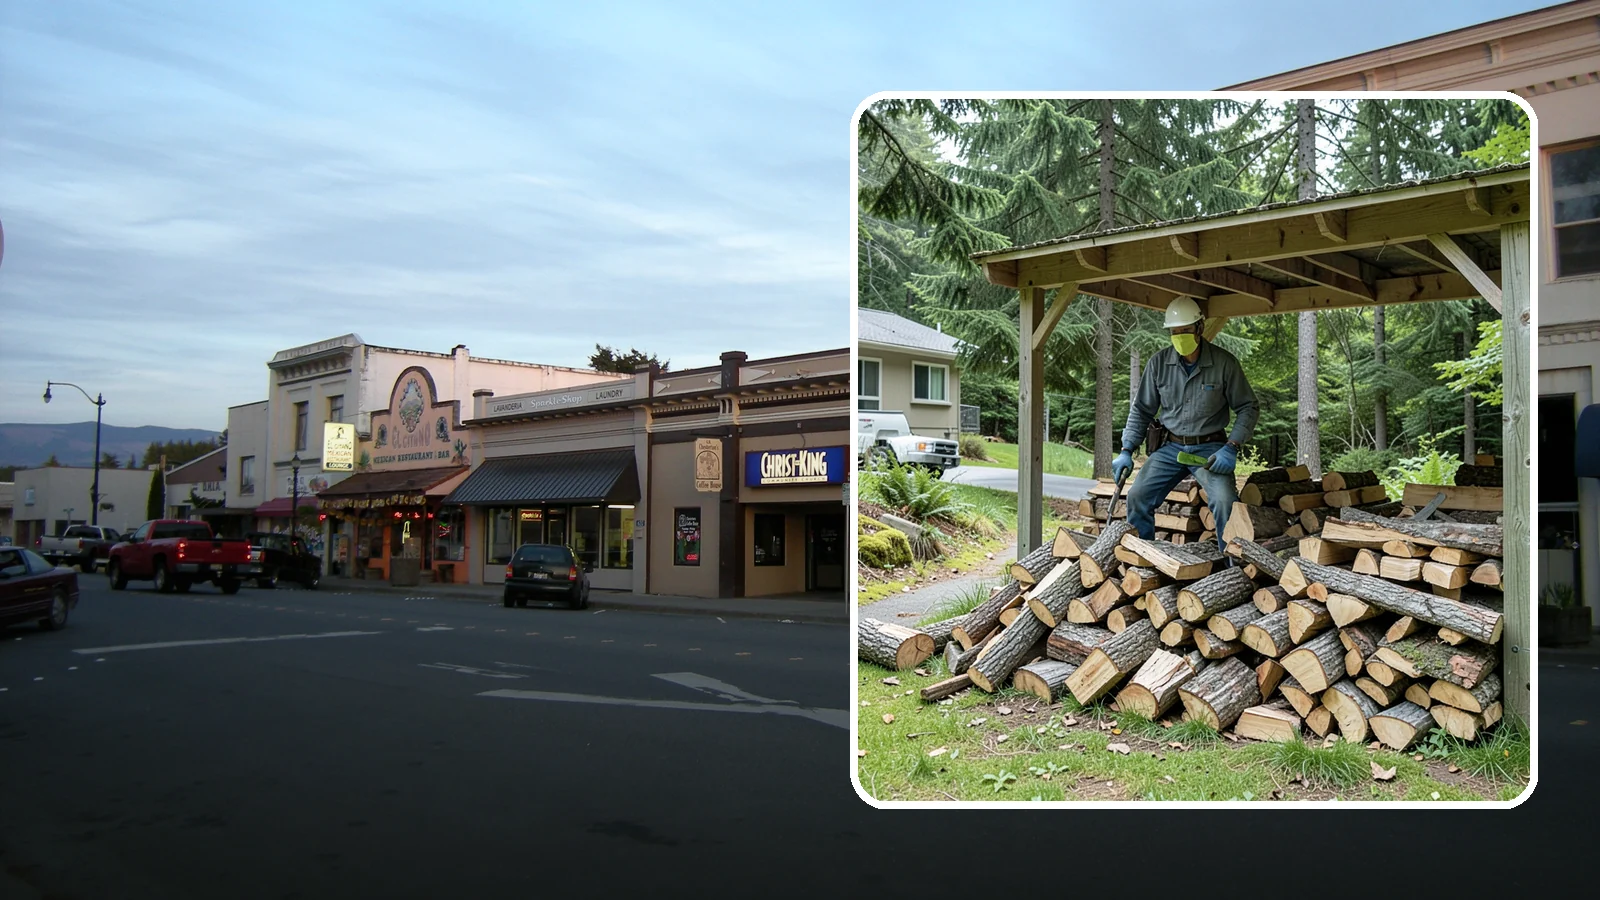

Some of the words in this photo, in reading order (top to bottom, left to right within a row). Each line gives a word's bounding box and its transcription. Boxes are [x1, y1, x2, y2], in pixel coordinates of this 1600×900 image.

[562, 394, 582, 405] Shop
[595, 389, 623, 400] LAUNDRY
[493, 403, 522, 412] LAVANDERIA
[374, 455, 396, 464] MEXICAN
[397, 451, 433, 462] RESTAURANT
[438, 450, 450, 459] BAR
[761, 452, 798, 477] CHRIST
[799, 450, 828, 476] KING
